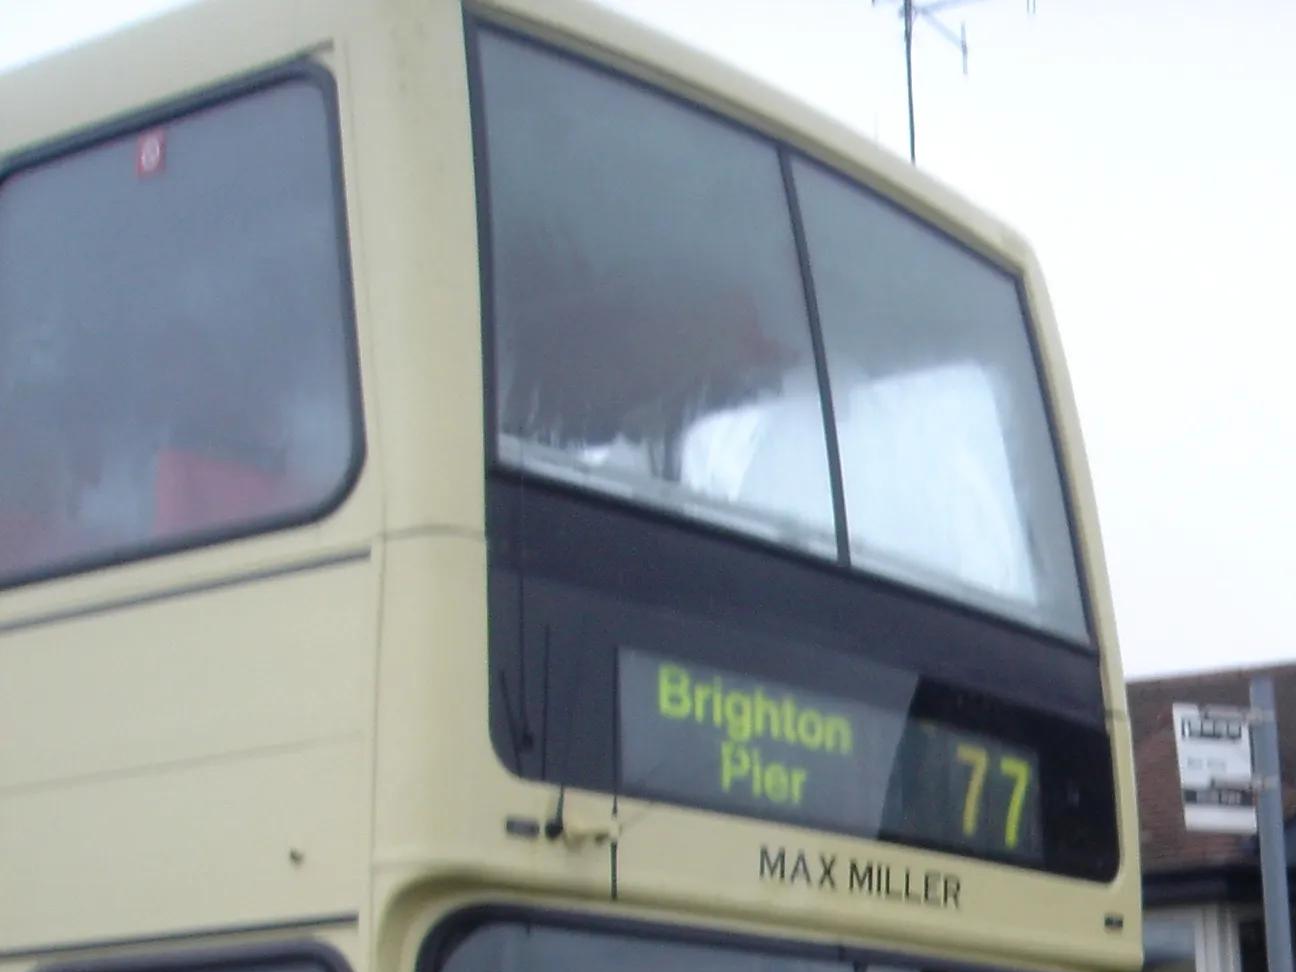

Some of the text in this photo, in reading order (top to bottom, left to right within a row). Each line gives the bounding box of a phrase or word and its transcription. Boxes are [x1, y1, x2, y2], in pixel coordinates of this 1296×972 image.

[658, 664, 853, 755] Brighton
[720, 740, 807, 806] Pier
[956, 745, 1031, 848] 77
[759, 845, 962, 910] MAX MILLER
